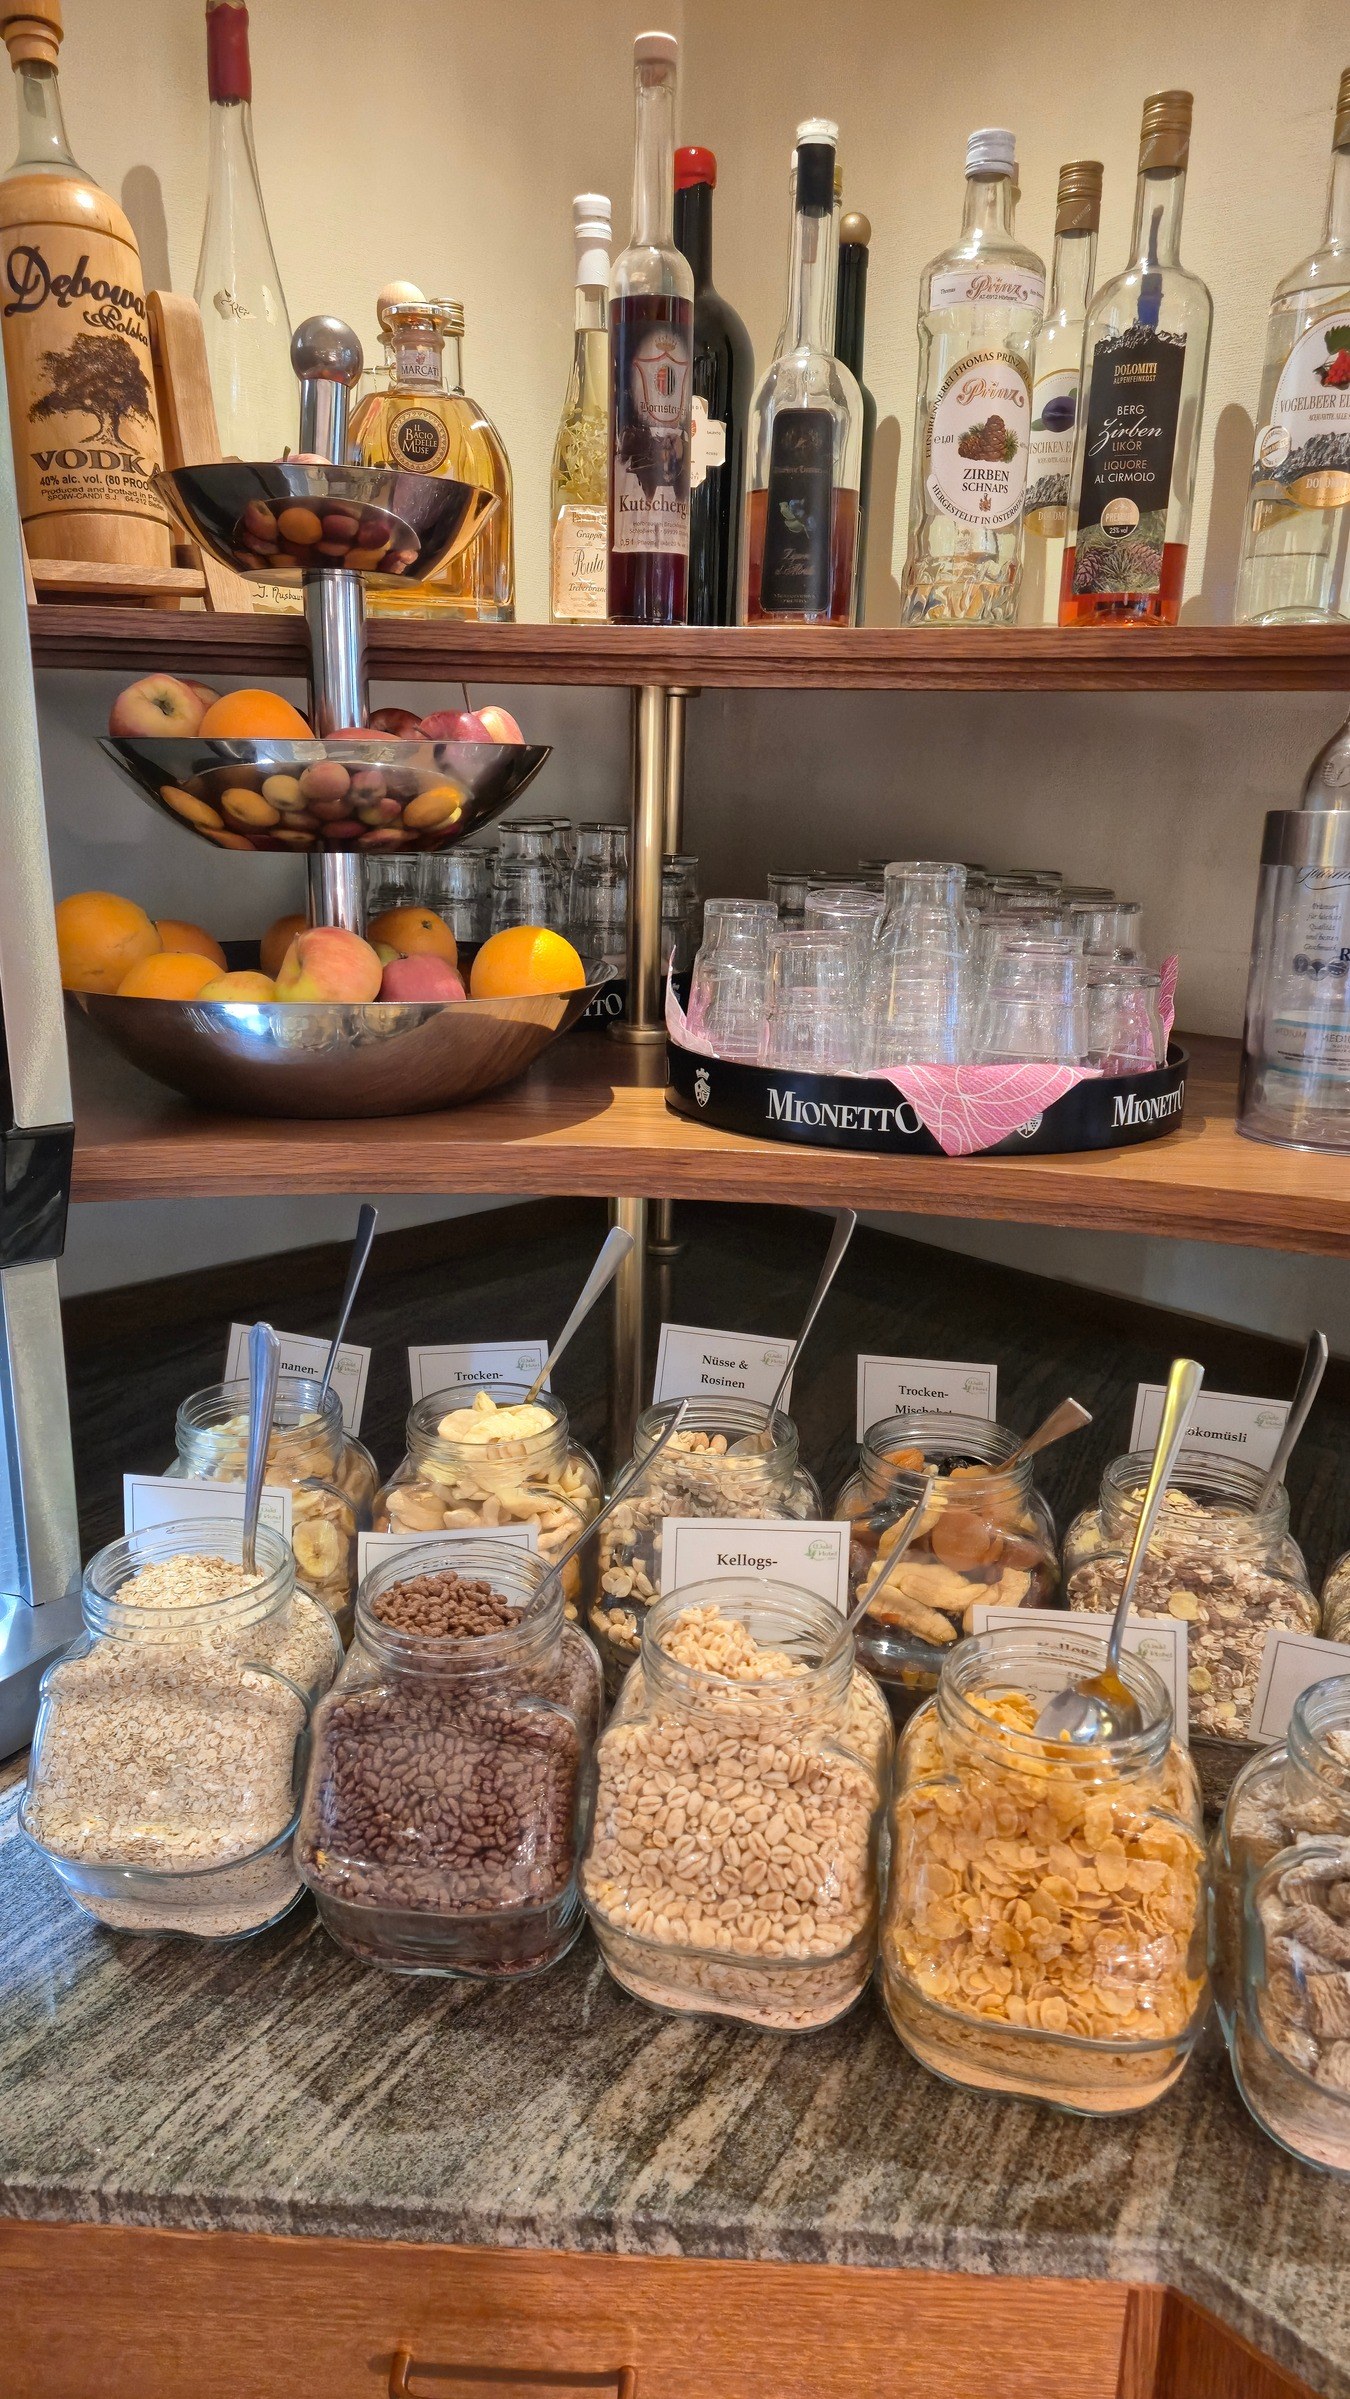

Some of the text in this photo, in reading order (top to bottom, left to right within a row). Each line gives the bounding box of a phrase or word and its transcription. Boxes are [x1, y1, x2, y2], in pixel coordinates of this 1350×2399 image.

[4, 246, 146, 320] Dębowa
[966, 275, 1028, 301] Prinz
[83, 305, 149, 347] Polska
[1114, 363, 1157, 376] DOLOMITI
[1113, 374, 1156, 384] ALPENFEINKOST
[956, 377, 1024, 408] Prinz
[926, 352, 1021, 458] FEINBRENNEREI THOMAS PRINZ
[1117, 405, 1144, 415] BERG
[1280, 395, 1336, 413] VOGELBEER
[406, 428, 433, 440] BACIO
[1088, 416, 1163, 457] Zirben
[402, 440, 429, 454] MUSE
[415, 439, 437, 447] DELLE
[1112, 438, 1142, 451] LIKÖR
[1104, 460, 1147, 470] LIQUORE
[963, 468, 1010, 482] ZIRBEN
[1094, 472, 1156, 484] AL CIRMOLO
[40, 474, 151, 492] 40% alc. vol. (80 PROO
[962, 482, 1009, 493] SCHNAPS
[41, 486, 83, 495] Produced
[619, 494, 689, 520] Kutscherg
[932, 484, 980, 524] HERGESTELLT
[281, 1361, 319, 1375] nanen-
[702, 1354, 749, 1370] Nüsse &
[454, 1371, 503, 1381] Trocken-
[701, 1373, 745, 1389] Rosinen
[899, 1385, 949, 1398] Trocken-
[1183, 1427, 1247, 1443] okomüsli
[717, 1554, 778, 1570] Kellogs-
